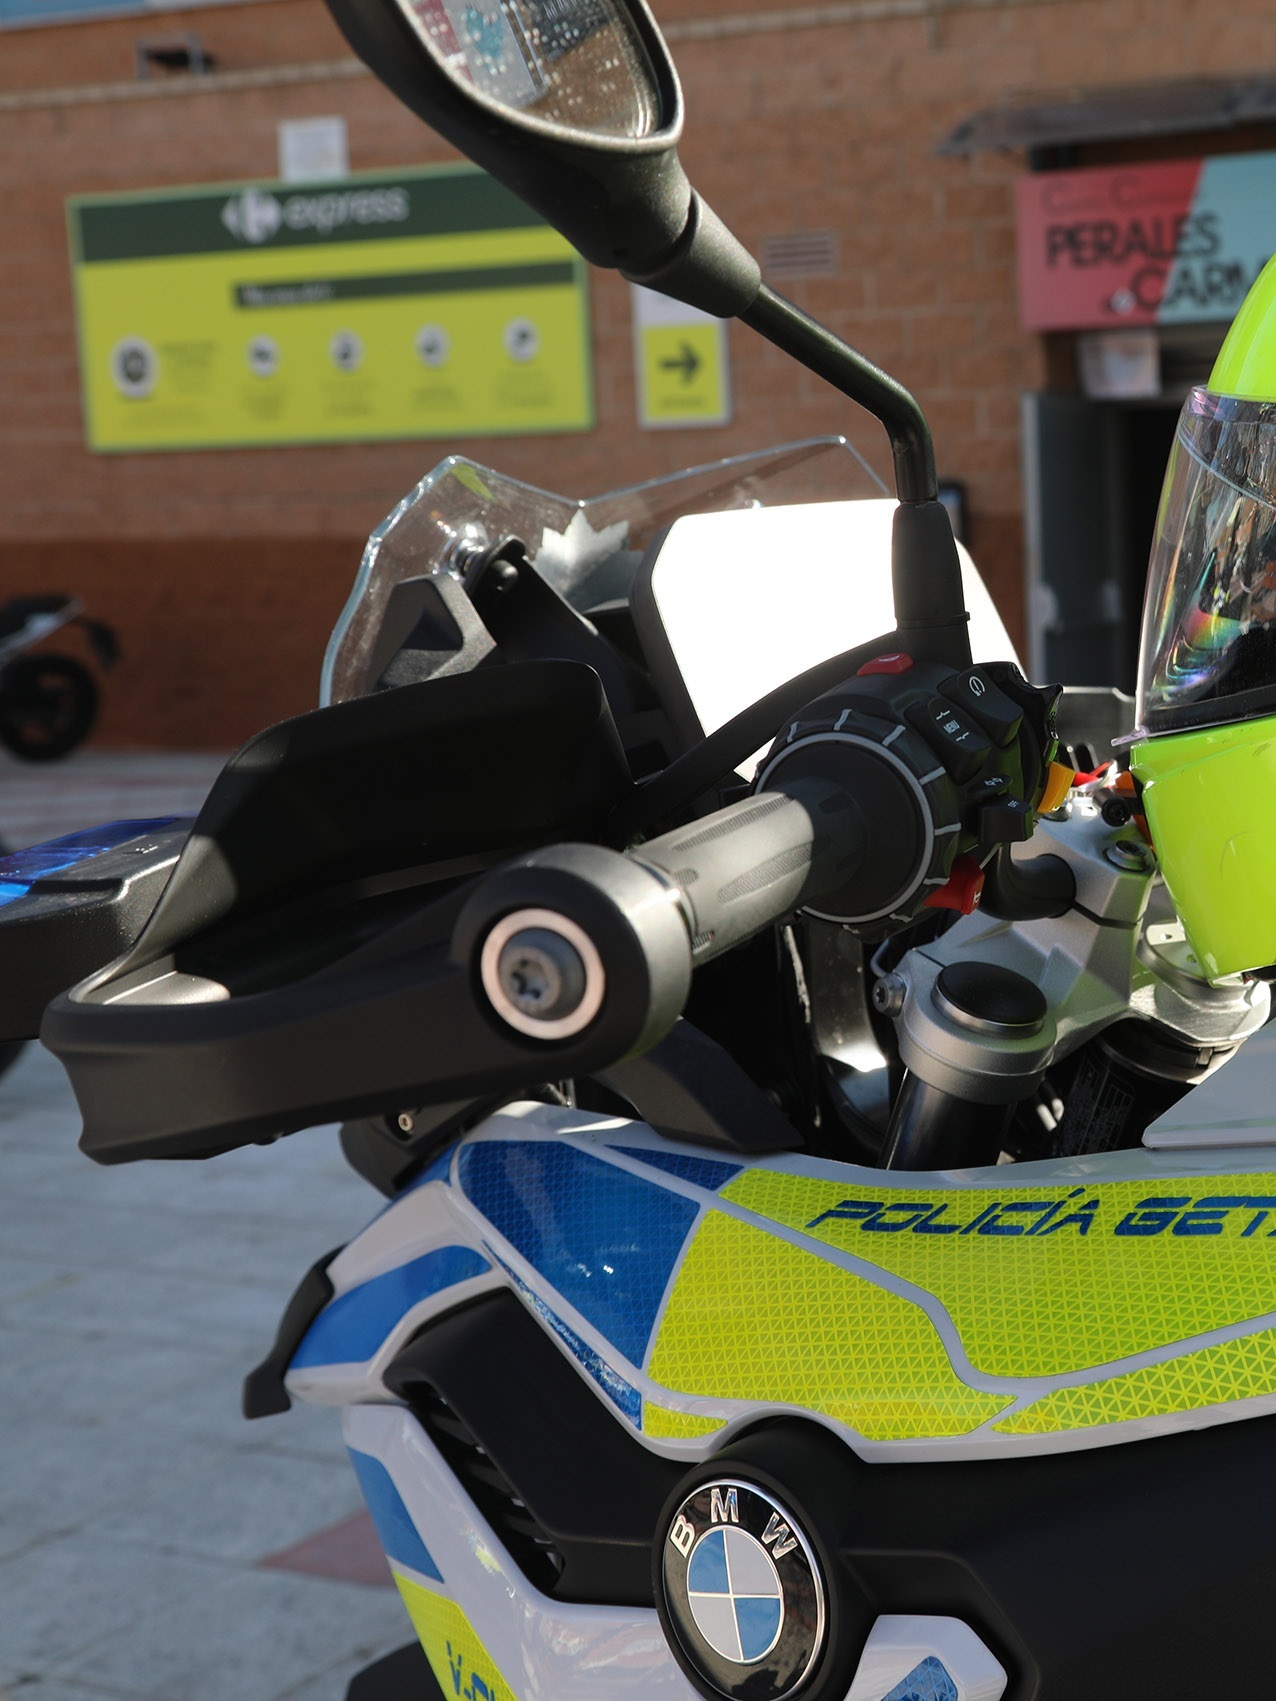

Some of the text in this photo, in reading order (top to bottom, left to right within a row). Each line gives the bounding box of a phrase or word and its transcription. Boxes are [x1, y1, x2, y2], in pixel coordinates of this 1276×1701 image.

[283, 186, 410, 236] express
[1046, 213, 1221, 268] PERALES
[806, 1188, 1100, 1236] POLICÍA
[669, 1487, 798, 1560] BMW
